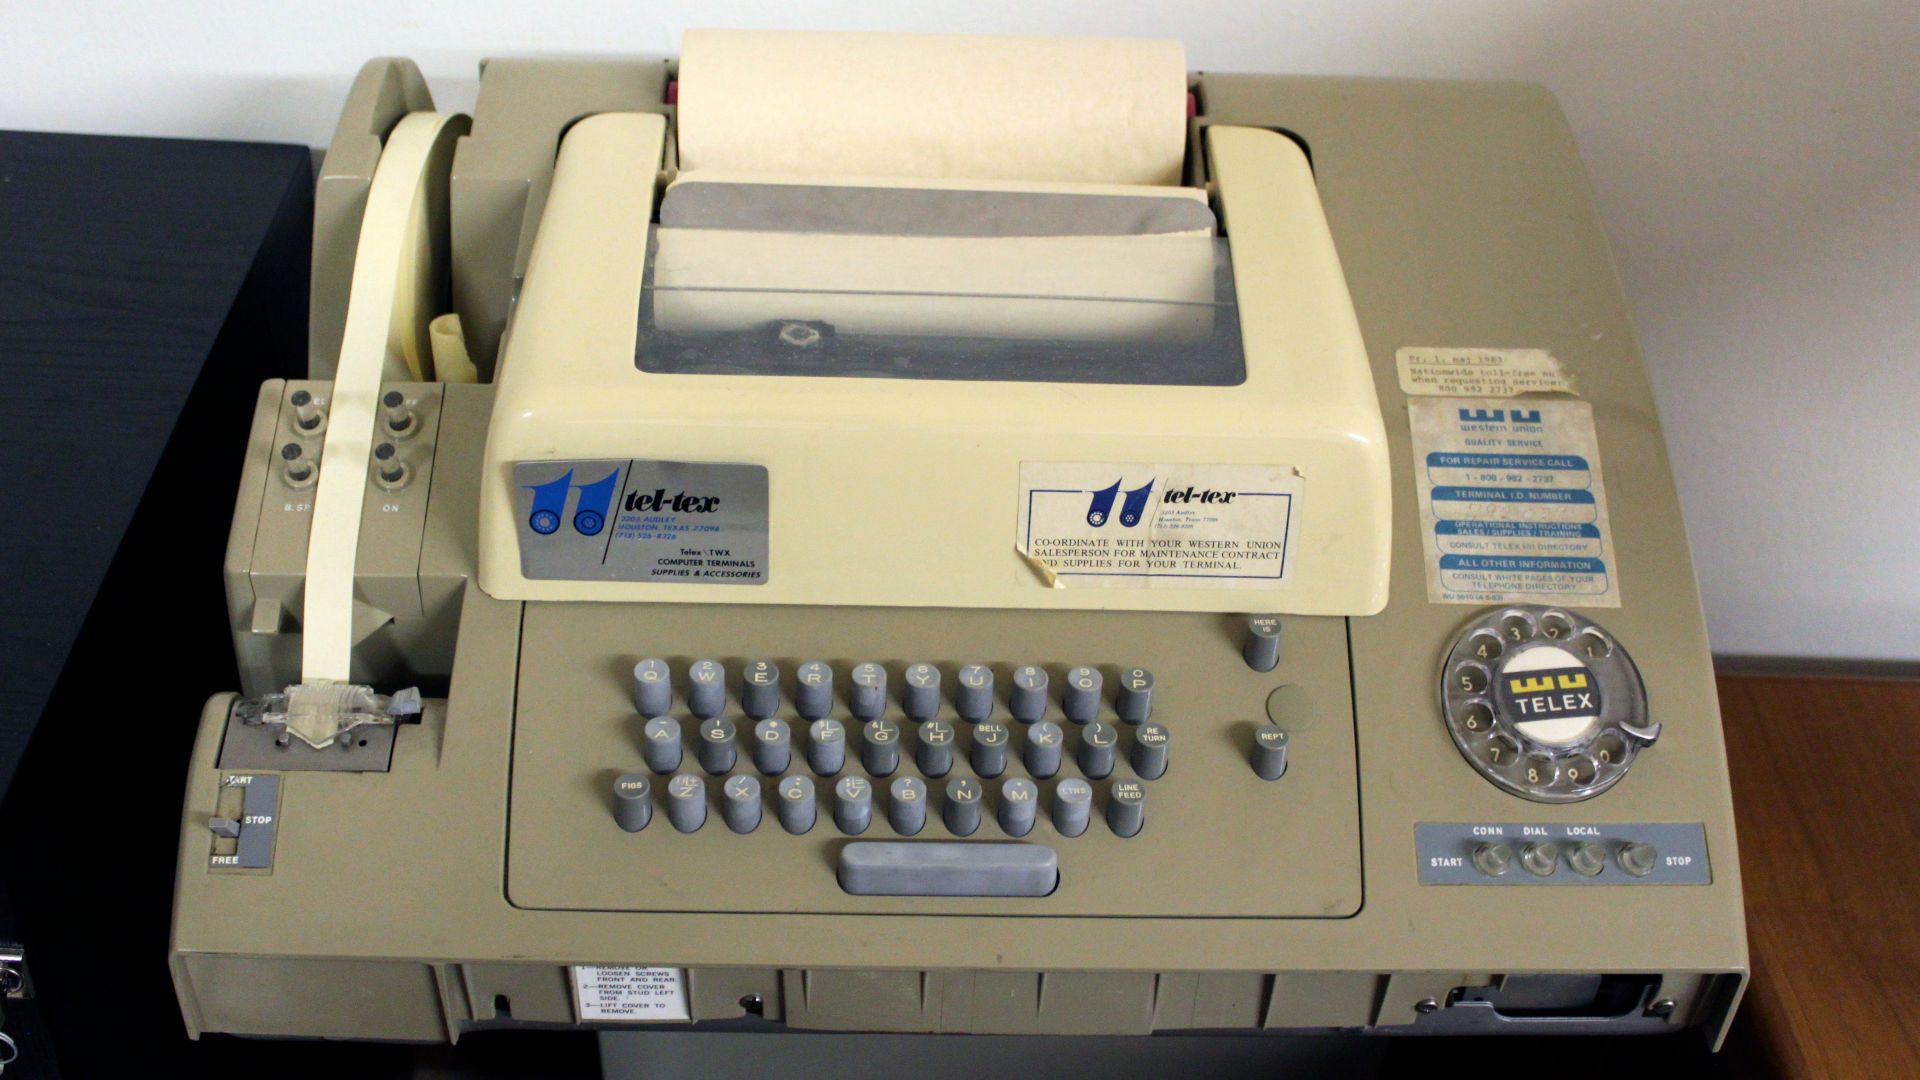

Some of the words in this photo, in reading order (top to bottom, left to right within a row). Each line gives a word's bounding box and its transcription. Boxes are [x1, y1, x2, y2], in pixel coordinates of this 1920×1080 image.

[1460, 423, 1507, 432] western
[1512, 424, 1544, 433] union
[1464, 438, 1502, 447] QUALITY
[1506, 439, 1544, 448] SERVICE
[1440, 456, 1461, 465] FOR
[1463, 457, 1500, 466] REPAIR
[1502, 458, 1545, 467] SERVICE
[1547, 459, 1574, 468] CALL
[625, 488, 720, 513] tel-tex
[1163, 487, 1236, 504] tel-tex
[1455, 490, 1508, 499] TERMINAL
[1528, 492, 1572, 501] NUMBER
[383, 504, 399, 512] ON
[1454, 521, 1516, 529] OPERATIONAL
[1519, 523, 1583, 531] INSTRUCTIONS
[1034, 538, 1109, 548] CO-ORDINATE
[1115, 539, 1145, 548] WITH
[1150, 540, 1181, 548] YOUR
[1188, 540, 1240, 549] WESTERN
[1246, 541, 1281, 549] UNION
[1449, 541, 1490, 549] CONSULT
[1538, 543, 1589, 551] DIRECTORY
[1034, 548, 1110, 558] SALESPERSON
[1113, 549, 1136, 558] FOR
[1140, 550, 1219, 559] MAINTENANCE
[1221, 551, 1280, 560] CONTRACT
[658, 559, 704, 567] COMPUTER
[707, 560, 756, 568] TERMINALS
[1063, 559, 1112, 568] SUPPLIES
[1117, 560, 1141, 569] FOR
[1146, 560, 1177, 569] YOUR
[1458, 559, 1479, 568] ALL
[1480, 560, 1516, 569] OTHER
[1519, 561, 1592, 570] INFORMATION
[650, 568, 690, 577] SUPPLIES
[703, 570, 761, 578] ACCESSORIES
[1452, 573, 1493, 581] CONSULT
[1495, 573, 1523, 582] WHITE
[1524, 574, 1554, 583] PAGES
[1555, 575, 1570, 583] OF
[1571, 575, 1595, 584] YOUR
[1472, 582, 1523, 591] TELEPHONE
[1525, 582, 1577, 591] DIRECTORY
[1511, 628, 1521, 640] 3
[1550, 628, 1559, 639] 2
[1477, 645, 1488, 658] 4
[703, 662, 713, 670] 2
[756, 662, 767, 670] 3
[809, 663, 820, 672] 4
[863, 664, 875, 673] 5
[917, 665, 929, 674] 6
[971, 665, 981, 674] 7
[643, 670, 658, 681] Q
[698, 671, 716, 681] W
[1025, 667, 1036, 676] 8
[1079, 668, 1090, 676] 9
[754, 672, 768, 683] E
[807, 673, 822, 683] R
[861, 674, 876, 684] T
[915, 675, 930, 685] Y
[969, 676, 984, 686] U
[1132, 679, 1146, 689] P
[1461, 677, 1473, 691] 5
[1515, 693, 1593, 714] TELEX
[1467, 715, 1477, 729] 6
[979, 724, 1002, 732] BELL
[654, 729, 669, 738] A
[711, 729, 725, 739] S
[765, 731, 779, 740] D
[821, 731, 834, 740] F
[874, 731, 888, 741] G
[929, 732, 943, 742] H
[986, 732, 997, 742] J
[1040, 733, 1053, 743] K
[1093, 734, 1109, 744] L
[1490, 750, 1500, 763] 7
[1528, 768, 1538, 782] 8
[1568, 768, 1578, 781] 9
[680, 786, 694, 797] Z
[735, 787, 750, 797] X
[1118, 783, 1139, 791] LINE
[787, 788, 802, 799] C
[846, 787, 860, 798] V
[902, 789, 916, 799] B
[957, 789, 972, 800] N
[1011, 790, 1028, 800] M
[1118, 791, 1142, 799] FEED
[245, 816, 272, 824] STOP
[1473, 827, 1503, 835] CONN
[1524, 827, 1547, 835] DIAL
[1566, 827, 1600, 836] LOCAL
[212, 856, 239, 865] FREE
[1431, 857, 1462, 867] START
[1666, 857, 1692, 866] STOP
